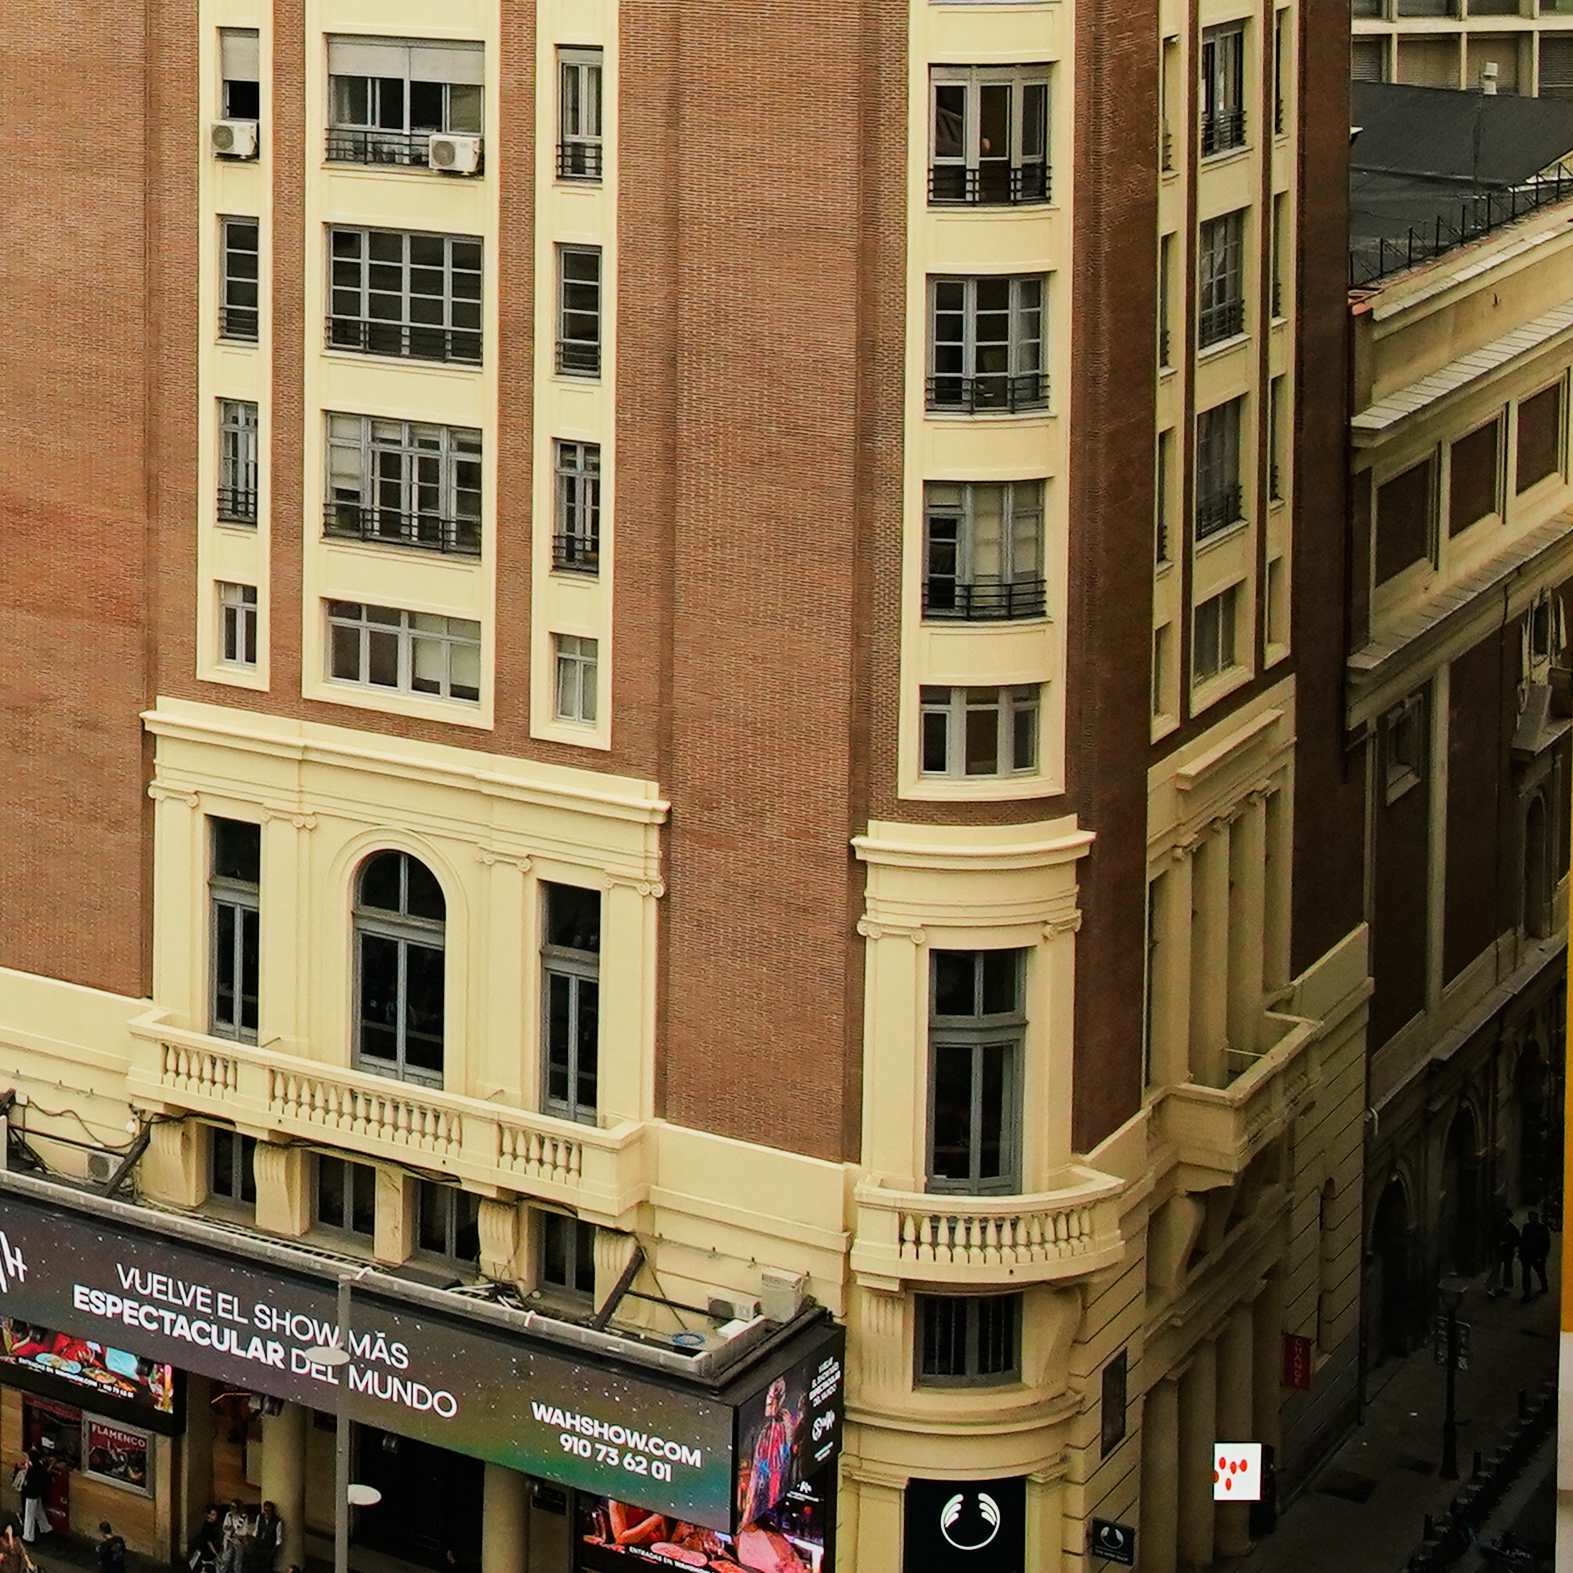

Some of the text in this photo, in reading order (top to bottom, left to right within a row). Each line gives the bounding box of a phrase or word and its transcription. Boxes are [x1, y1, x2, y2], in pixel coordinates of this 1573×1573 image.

[116, 1263, 410, 1370] VUELVE EL SHOW MÁS
[73, 1284, 459, 1419] ESPECTACULAR DEL MUNDO
[91, 1422, 146, 1448] FLAMENCO
[531, 1401, 702, 1469] WAHSHOW.COM
[559, 1433, 672, 1483] 910 73 62 01
